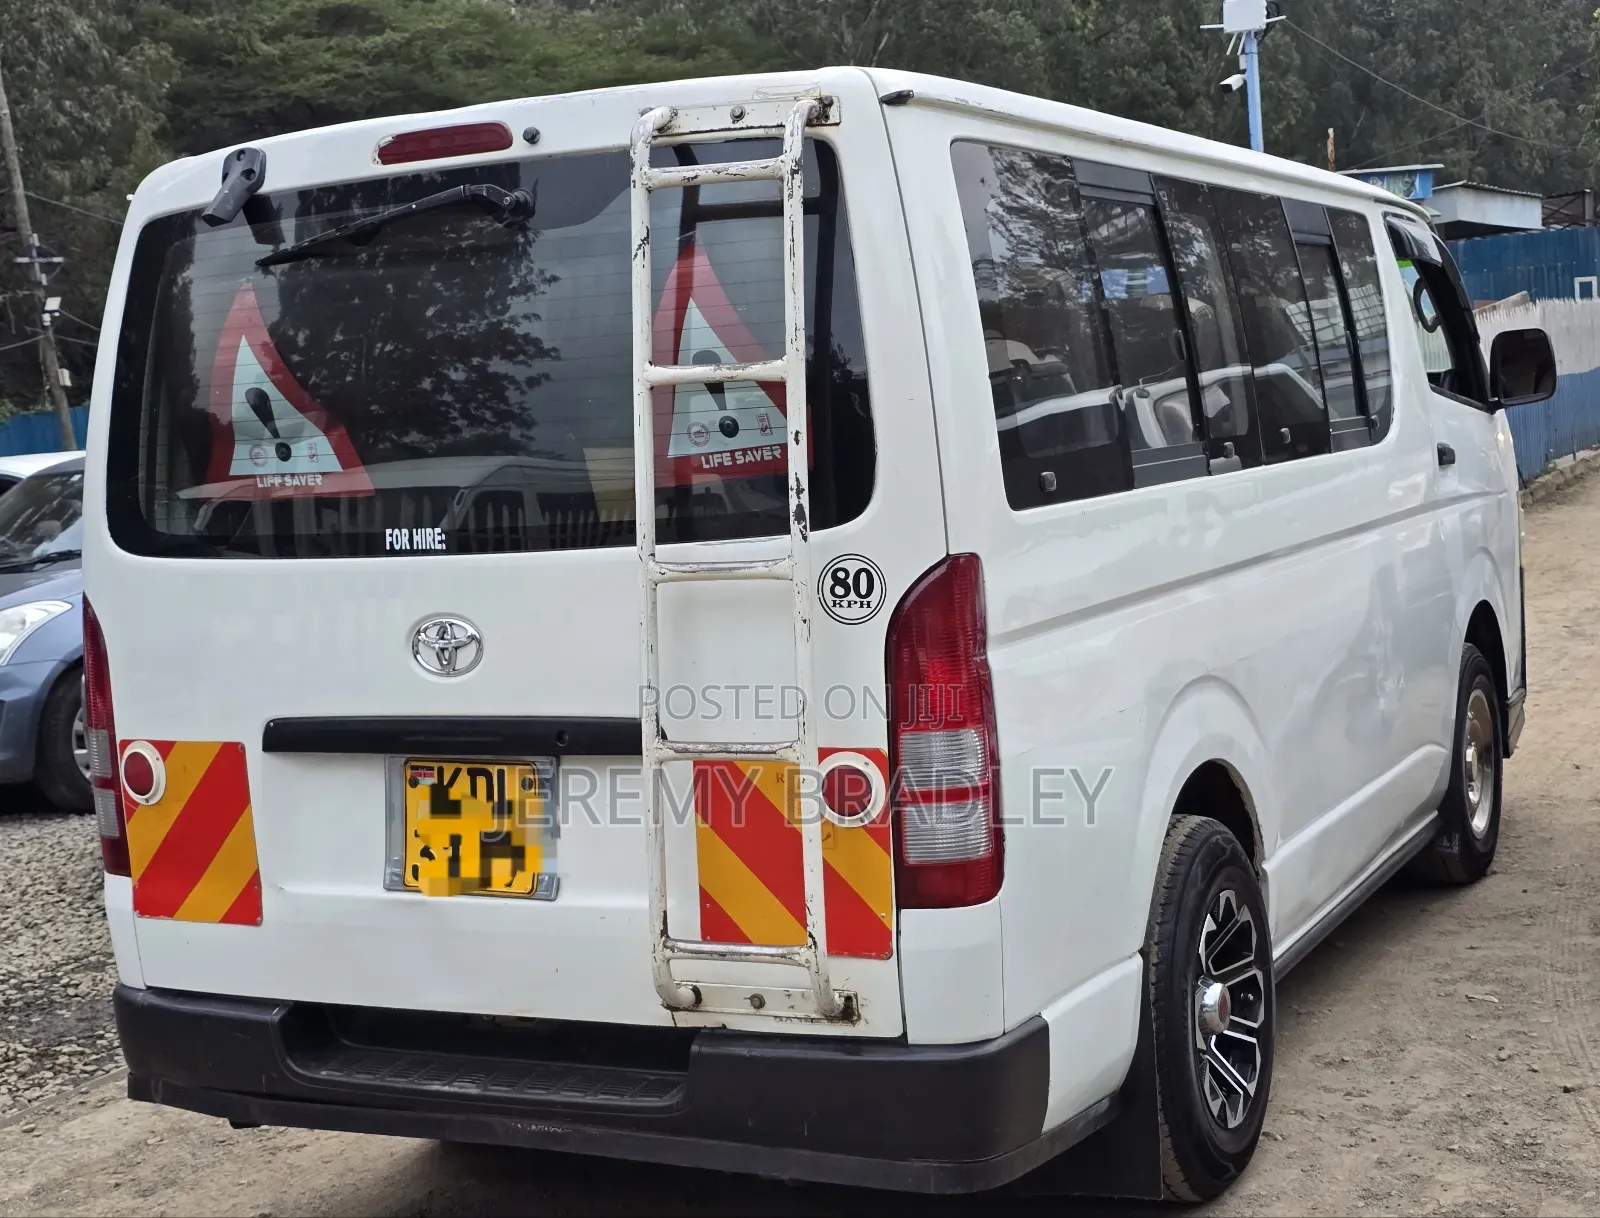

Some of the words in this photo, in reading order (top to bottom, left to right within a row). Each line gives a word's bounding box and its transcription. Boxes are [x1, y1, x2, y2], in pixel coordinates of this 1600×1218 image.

[701, 452, 733, 469] LIFE
[735, 445, 782, 465] SAVER
[284, 473, 323, 487] SAVER
[385, 528, 411, 550] FOR
[829, 567, 875, 599] 80
[830, 600, 873, 609] KPH
